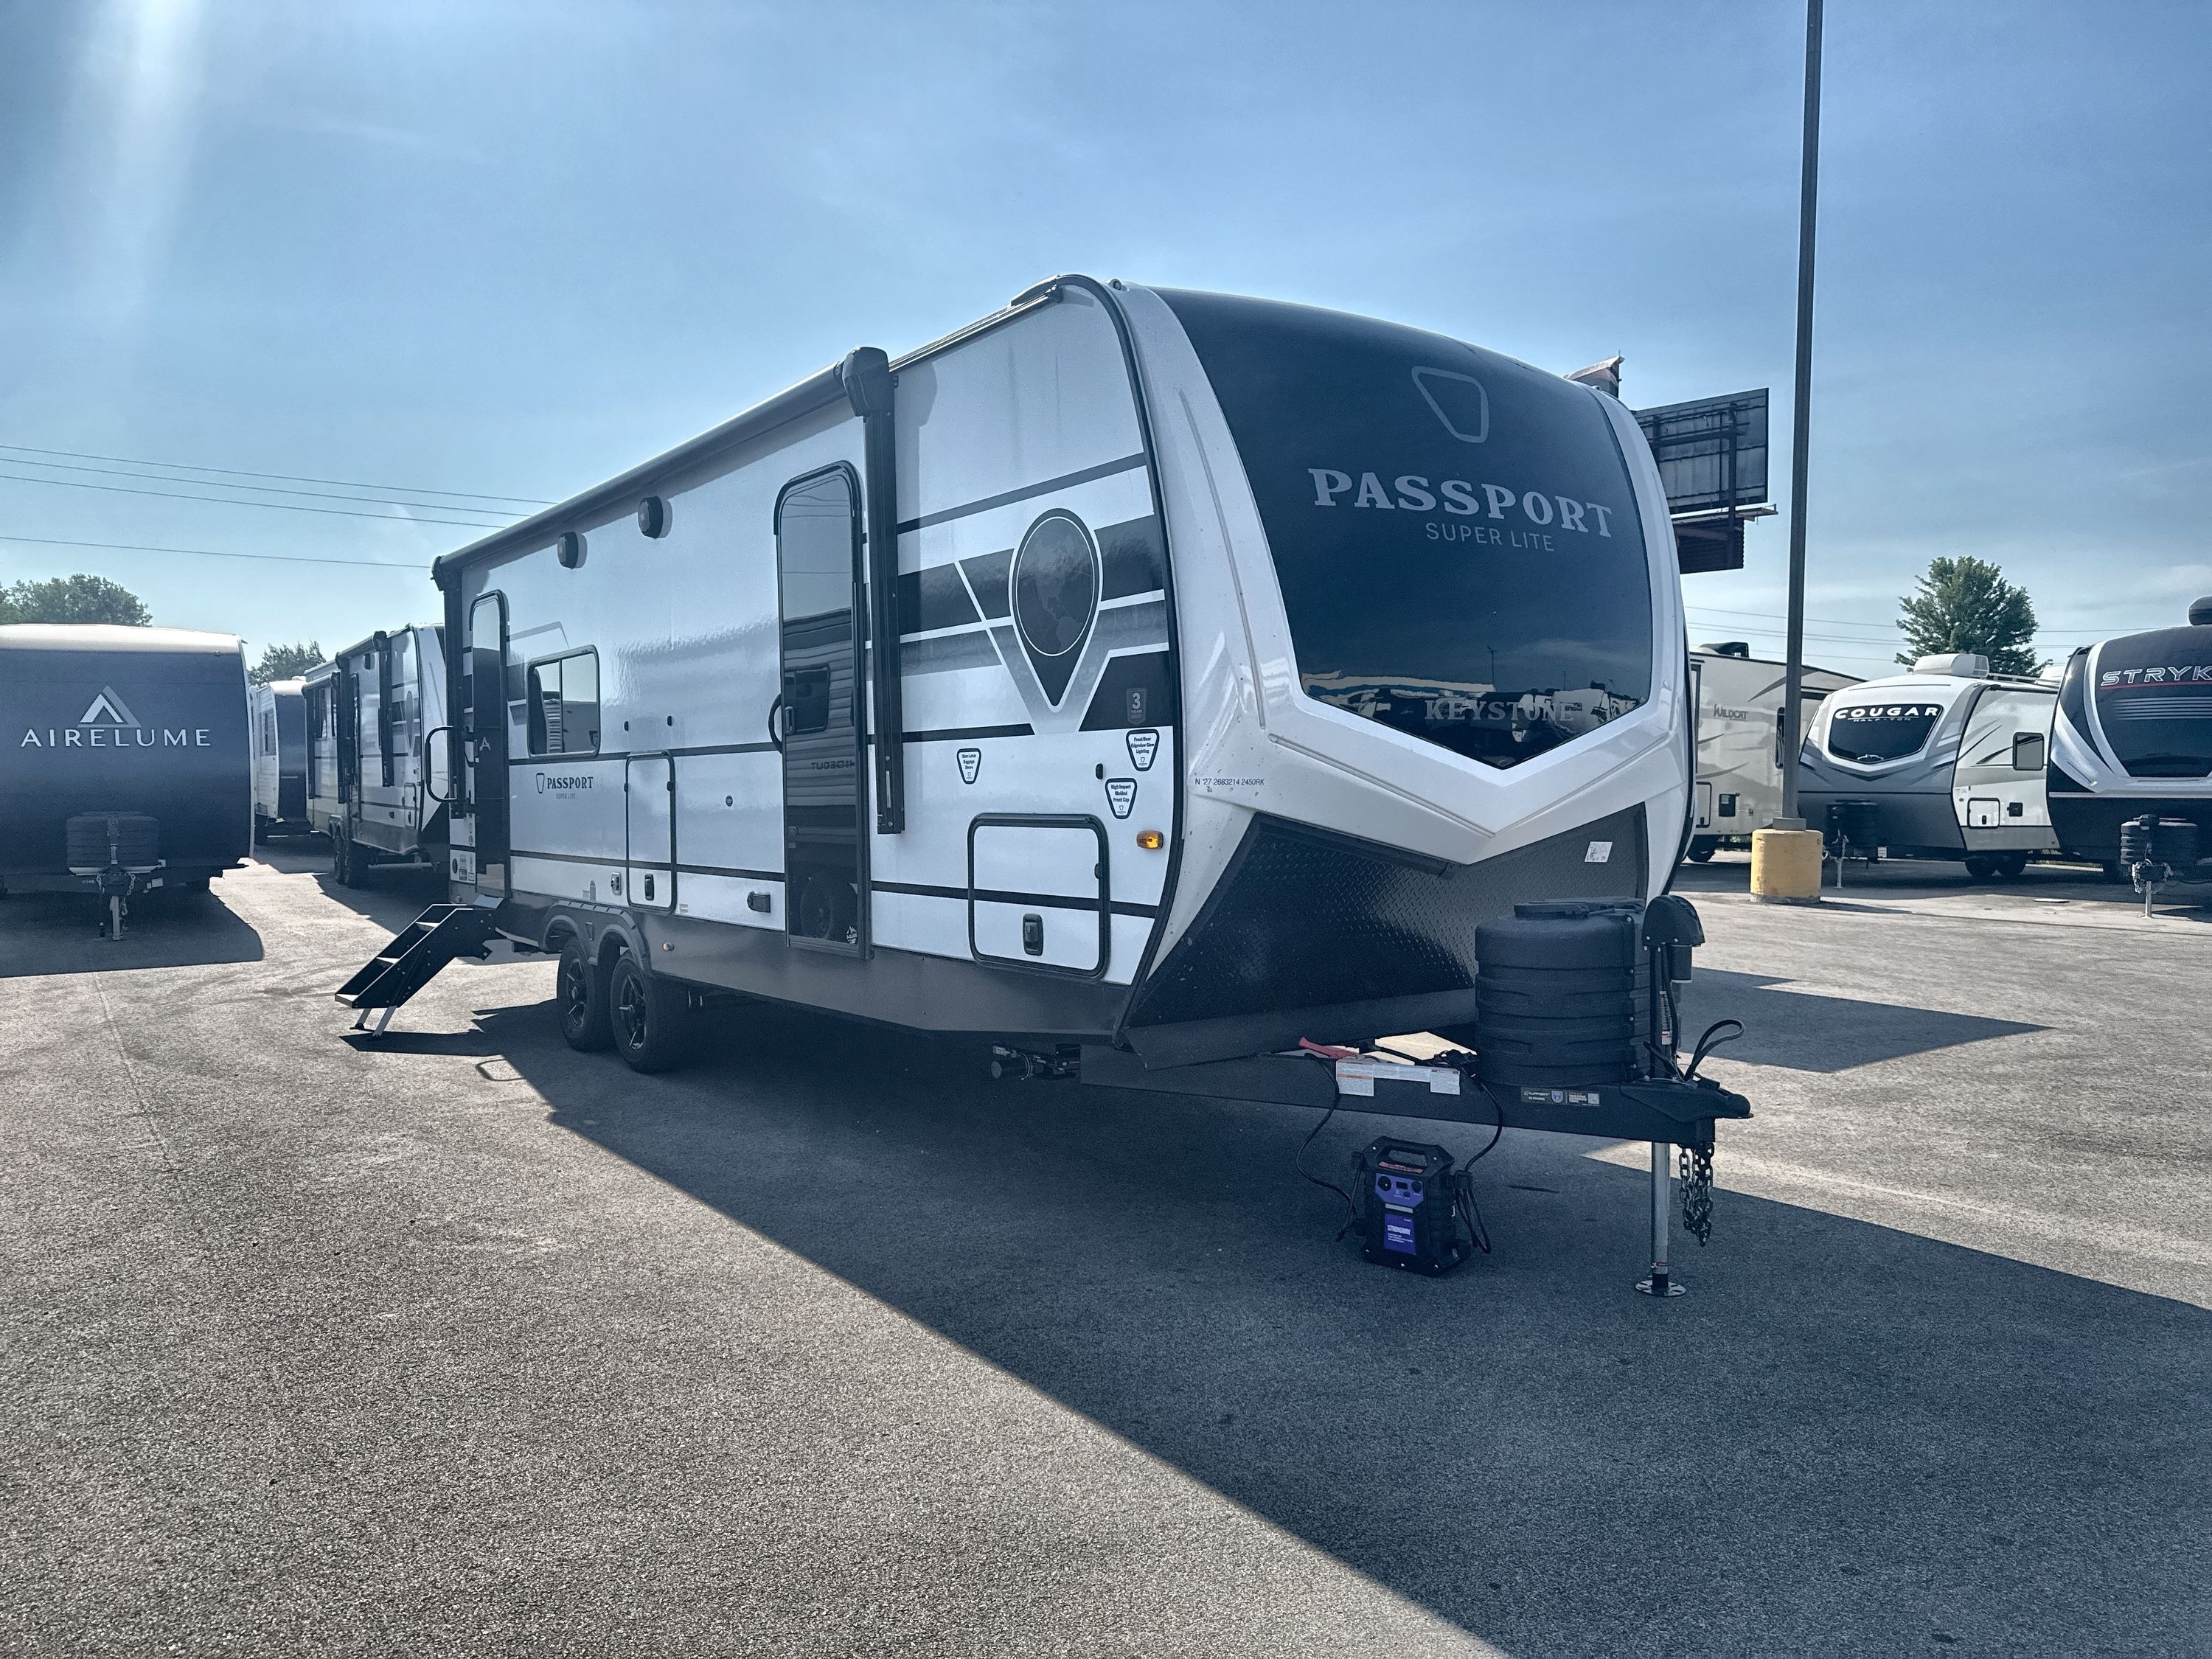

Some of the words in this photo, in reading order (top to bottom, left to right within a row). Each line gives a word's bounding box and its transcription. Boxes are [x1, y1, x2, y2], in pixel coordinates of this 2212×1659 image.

[1308, 468, 1613, 538] PASSPORT
[1425, 522, 1503, 546] SUPER
[1511, 530, 1554, 552] LITE
[2101, 665, 2212, 686] STRYK
[1132, 692, 1141, 709] 3
[1425, 700, 1574, 721] KEYSTONE
[1714, 703, 1748, 720] WILDCAT
[1834, 706, 1938, 719] COUGAR
[21, 728, 211, 747] AIRELUME
[547, 776, 593, 789] PASSPORT
